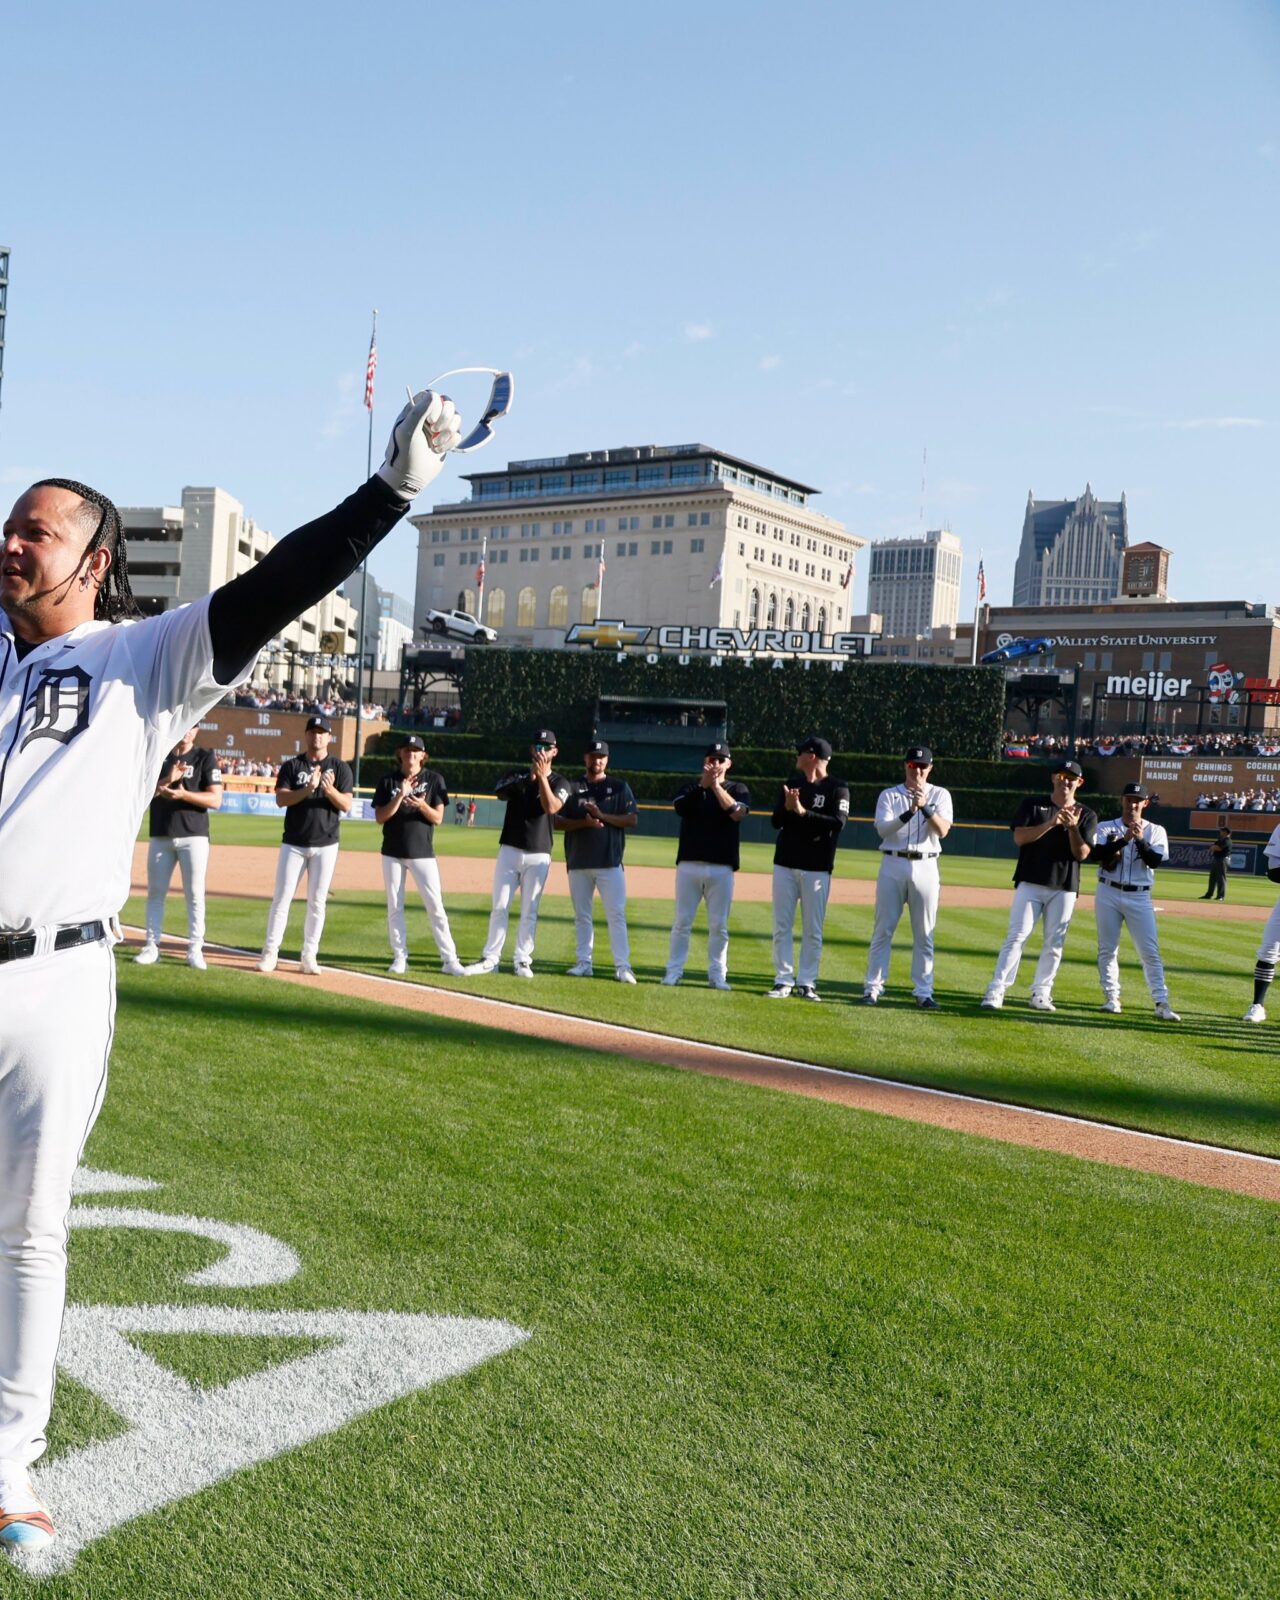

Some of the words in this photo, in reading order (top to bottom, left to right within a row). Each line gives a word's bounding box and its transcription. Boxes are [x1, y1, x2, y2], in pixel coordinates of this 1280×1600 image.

[658, 626, 881, 655] CHEVROLET
[1055, 635, 1098, 647] VALLEY
[1099, 635, 1137, 646] STATE
[1138, 635, 1217, 646] UNIVERSITY
[617, 652, 844, 672] FOUNTAIN
[1107, 671, 1192, 701] meijer
[20, 664, 93, 753] D
[257, 713, 270, 725] 16
[226, 735, 235, 746] 3
[1144, 761, 1182, 770] HEILMANN
[1195, 762, 1233, 772] JENNINGS
[1146, 772, 1178, 781] MANUSH
[1192, 775, 1234, 783] CRAWFORD
[1256, 774, 1275, 783] KELL
